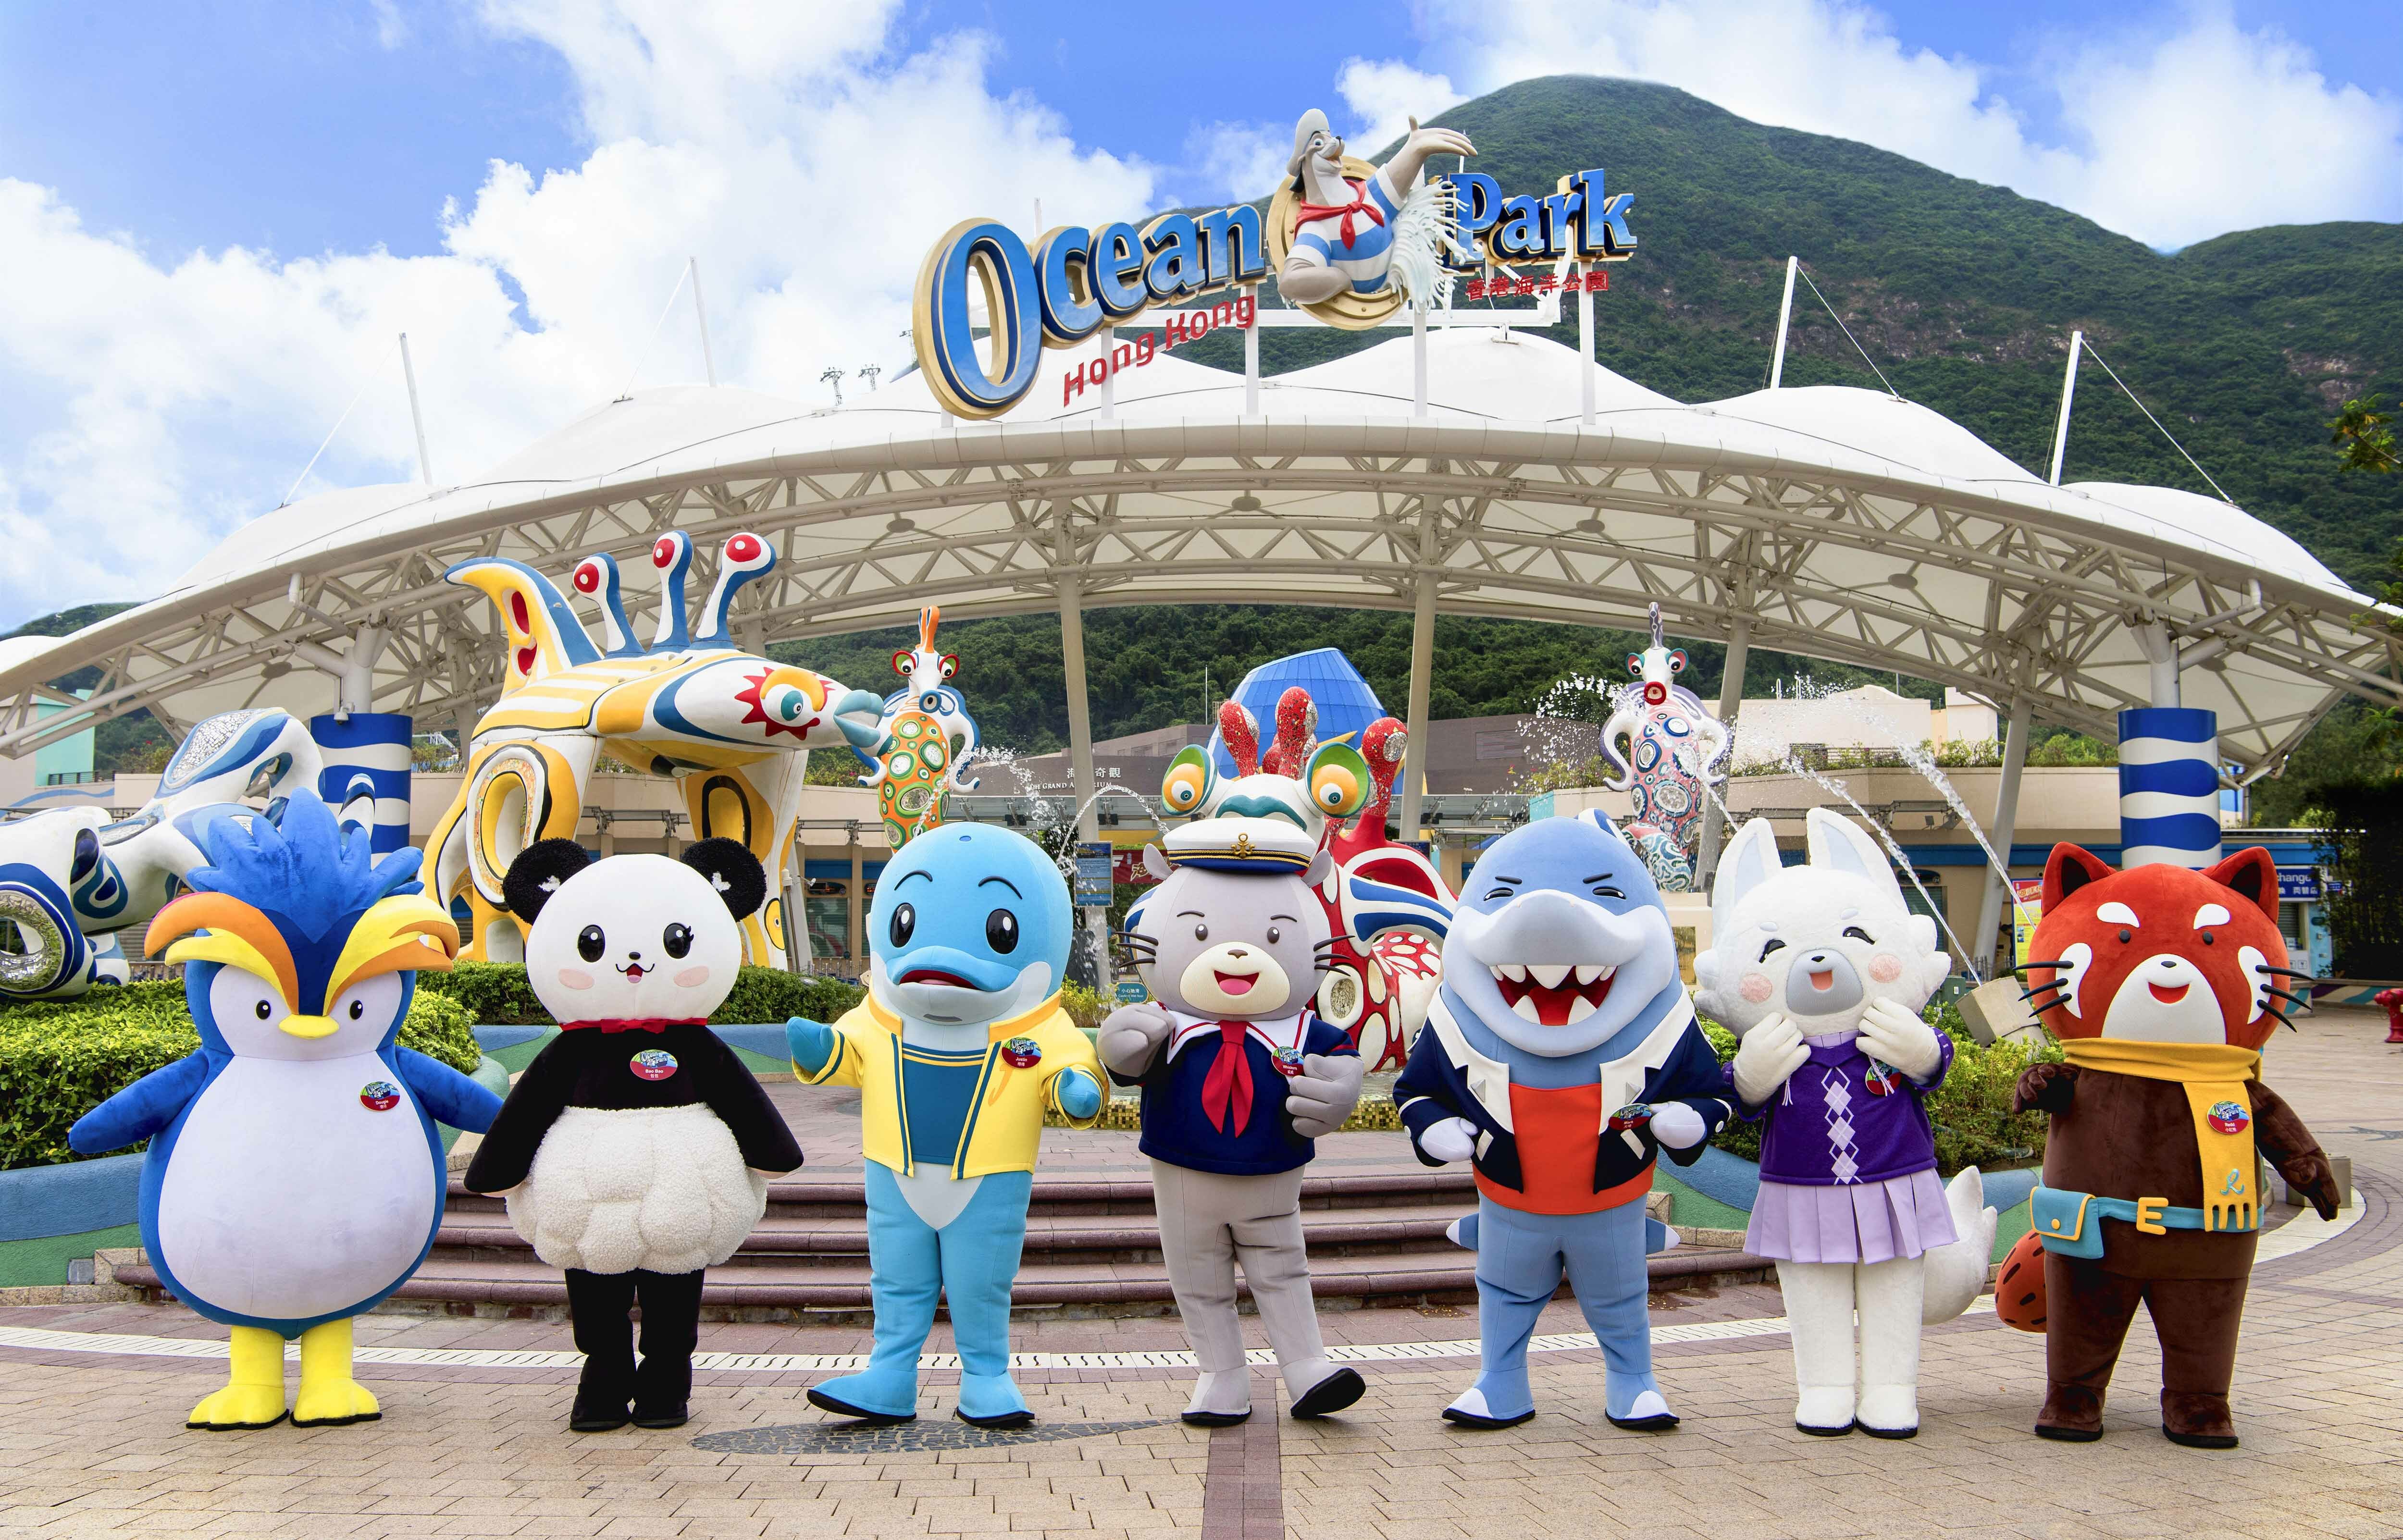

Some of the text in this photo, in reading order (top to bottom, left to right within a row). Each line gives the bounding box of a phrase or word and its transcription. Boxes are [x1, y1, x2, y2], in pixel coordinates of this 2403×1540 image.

[1465, 271, 1609, 302] 香港海洋公園
[912, 168, 1637, 420] Ocean Park
[1064, 295, 1255, 407] Hong Kong
[1067, 767, 1121, 778] 海奇觀
[1011, 1038, 1027, 1049] Ocean
[640, 1051, 659, 1062] Ocean
[366, 1084, 391, 1095] Ocean Park
